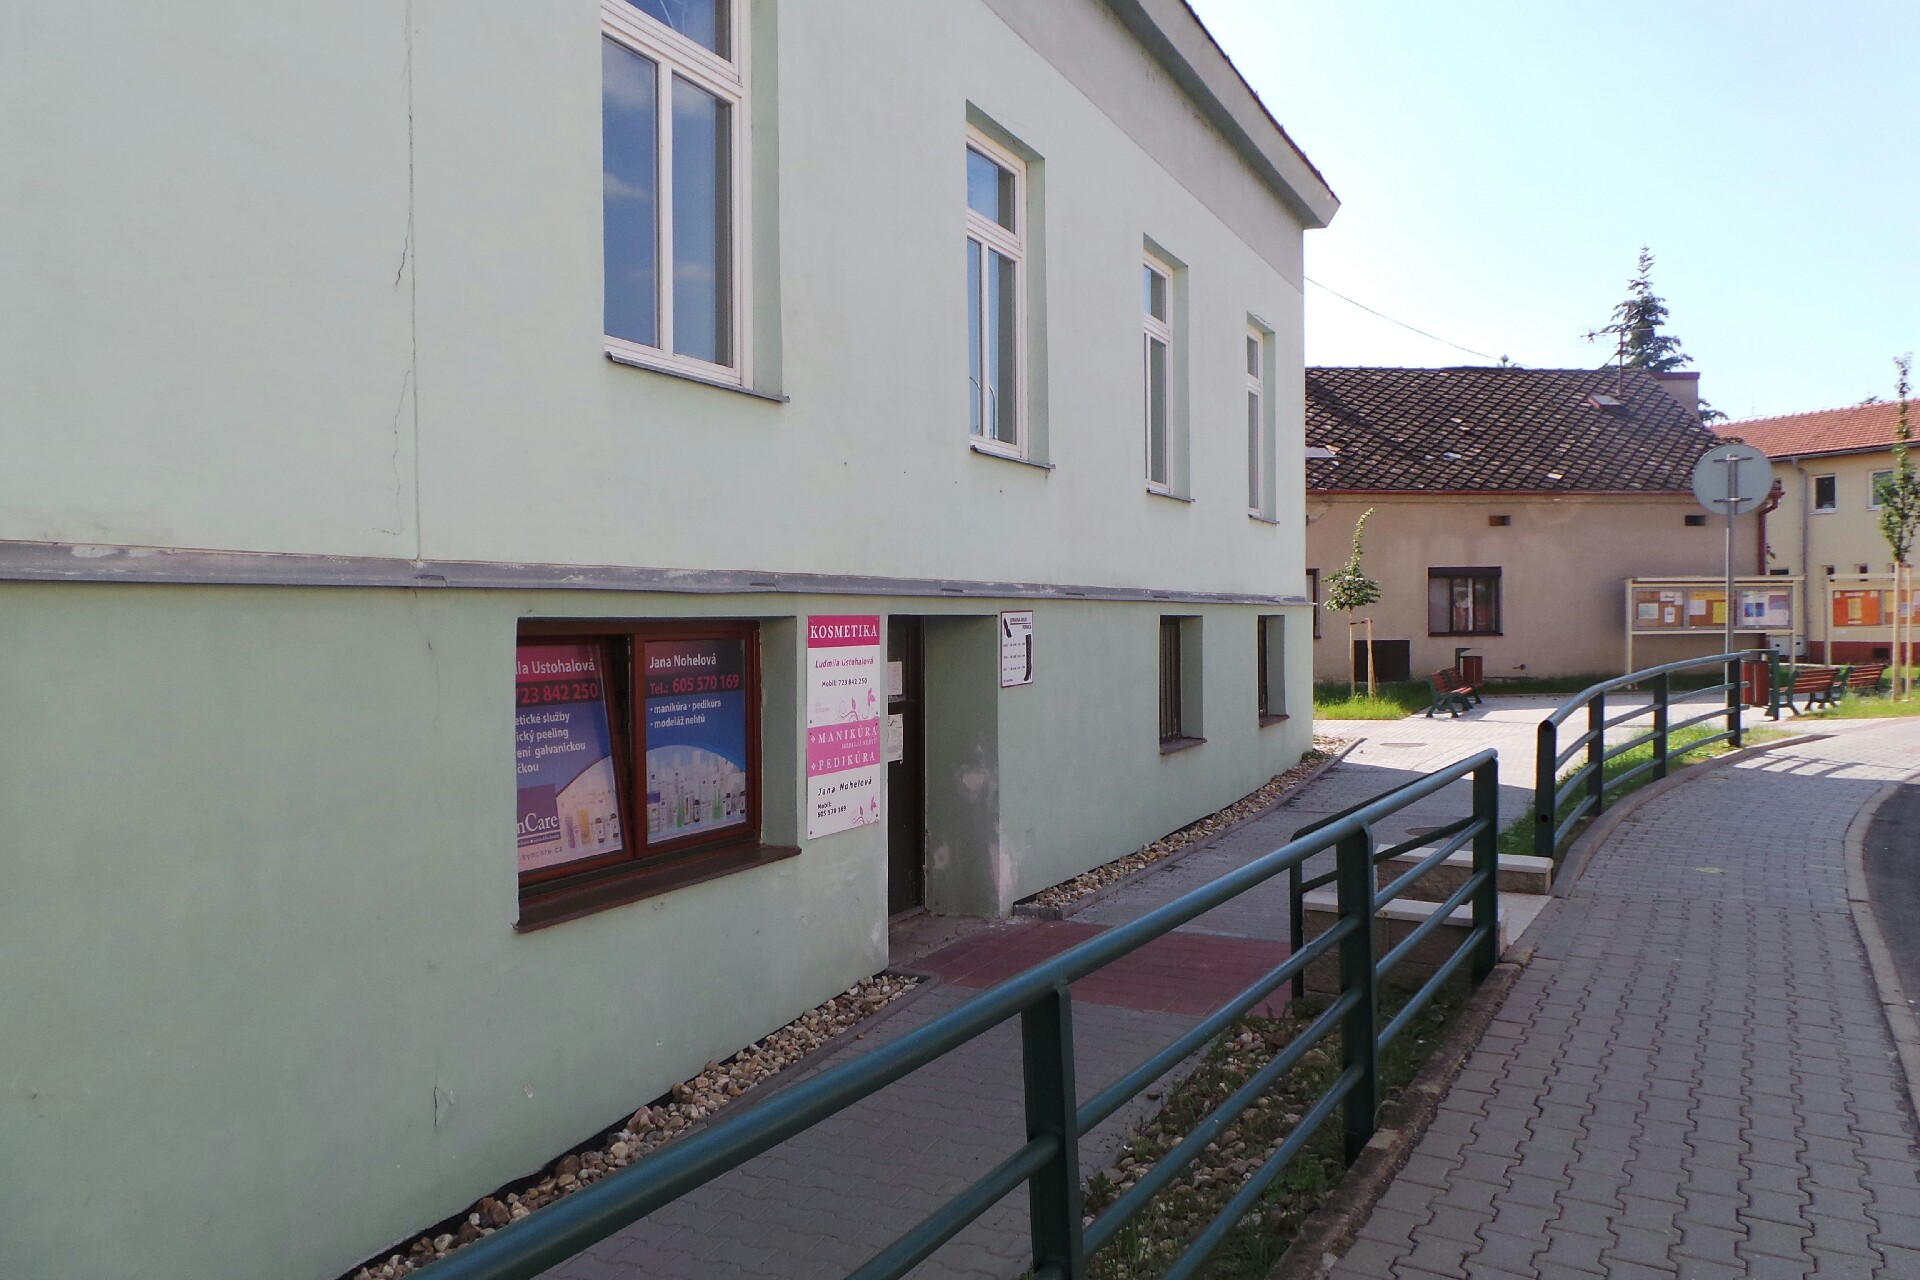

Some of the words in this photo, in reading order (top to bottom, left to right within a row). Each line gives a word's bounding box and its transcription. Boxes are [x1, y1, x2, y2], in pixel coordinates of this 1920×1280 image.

[811, 625, 877, 638] KOSMETIKA
[531, 658, 595, 674] Ustohalová
[649, 656, 672, 669] Jana
[673, 652, 717, 667] Nohelová
[815, 660, 840, 669] Ludmila
[543, 685, 569, 702] 842
[573, 682, 598, 699] 250
[650, 682, 669, 695] Tel.:
[672, 678, 694, 693] 605
[697, 676, 717, 691] 570
[720, 674, 739, 689] 169
[542, 711, 570, 723] služby
[536, 727, 569, 742] peeling
[818, 725, 877, 743] MANIKÚRA
[535, 742, 586, 758] galvanickou
[818, 751, 875, 770] PEDIKÚRA
[818, 785, 836, 797] Jana
[839, 776, 872, 792] Nohelová
